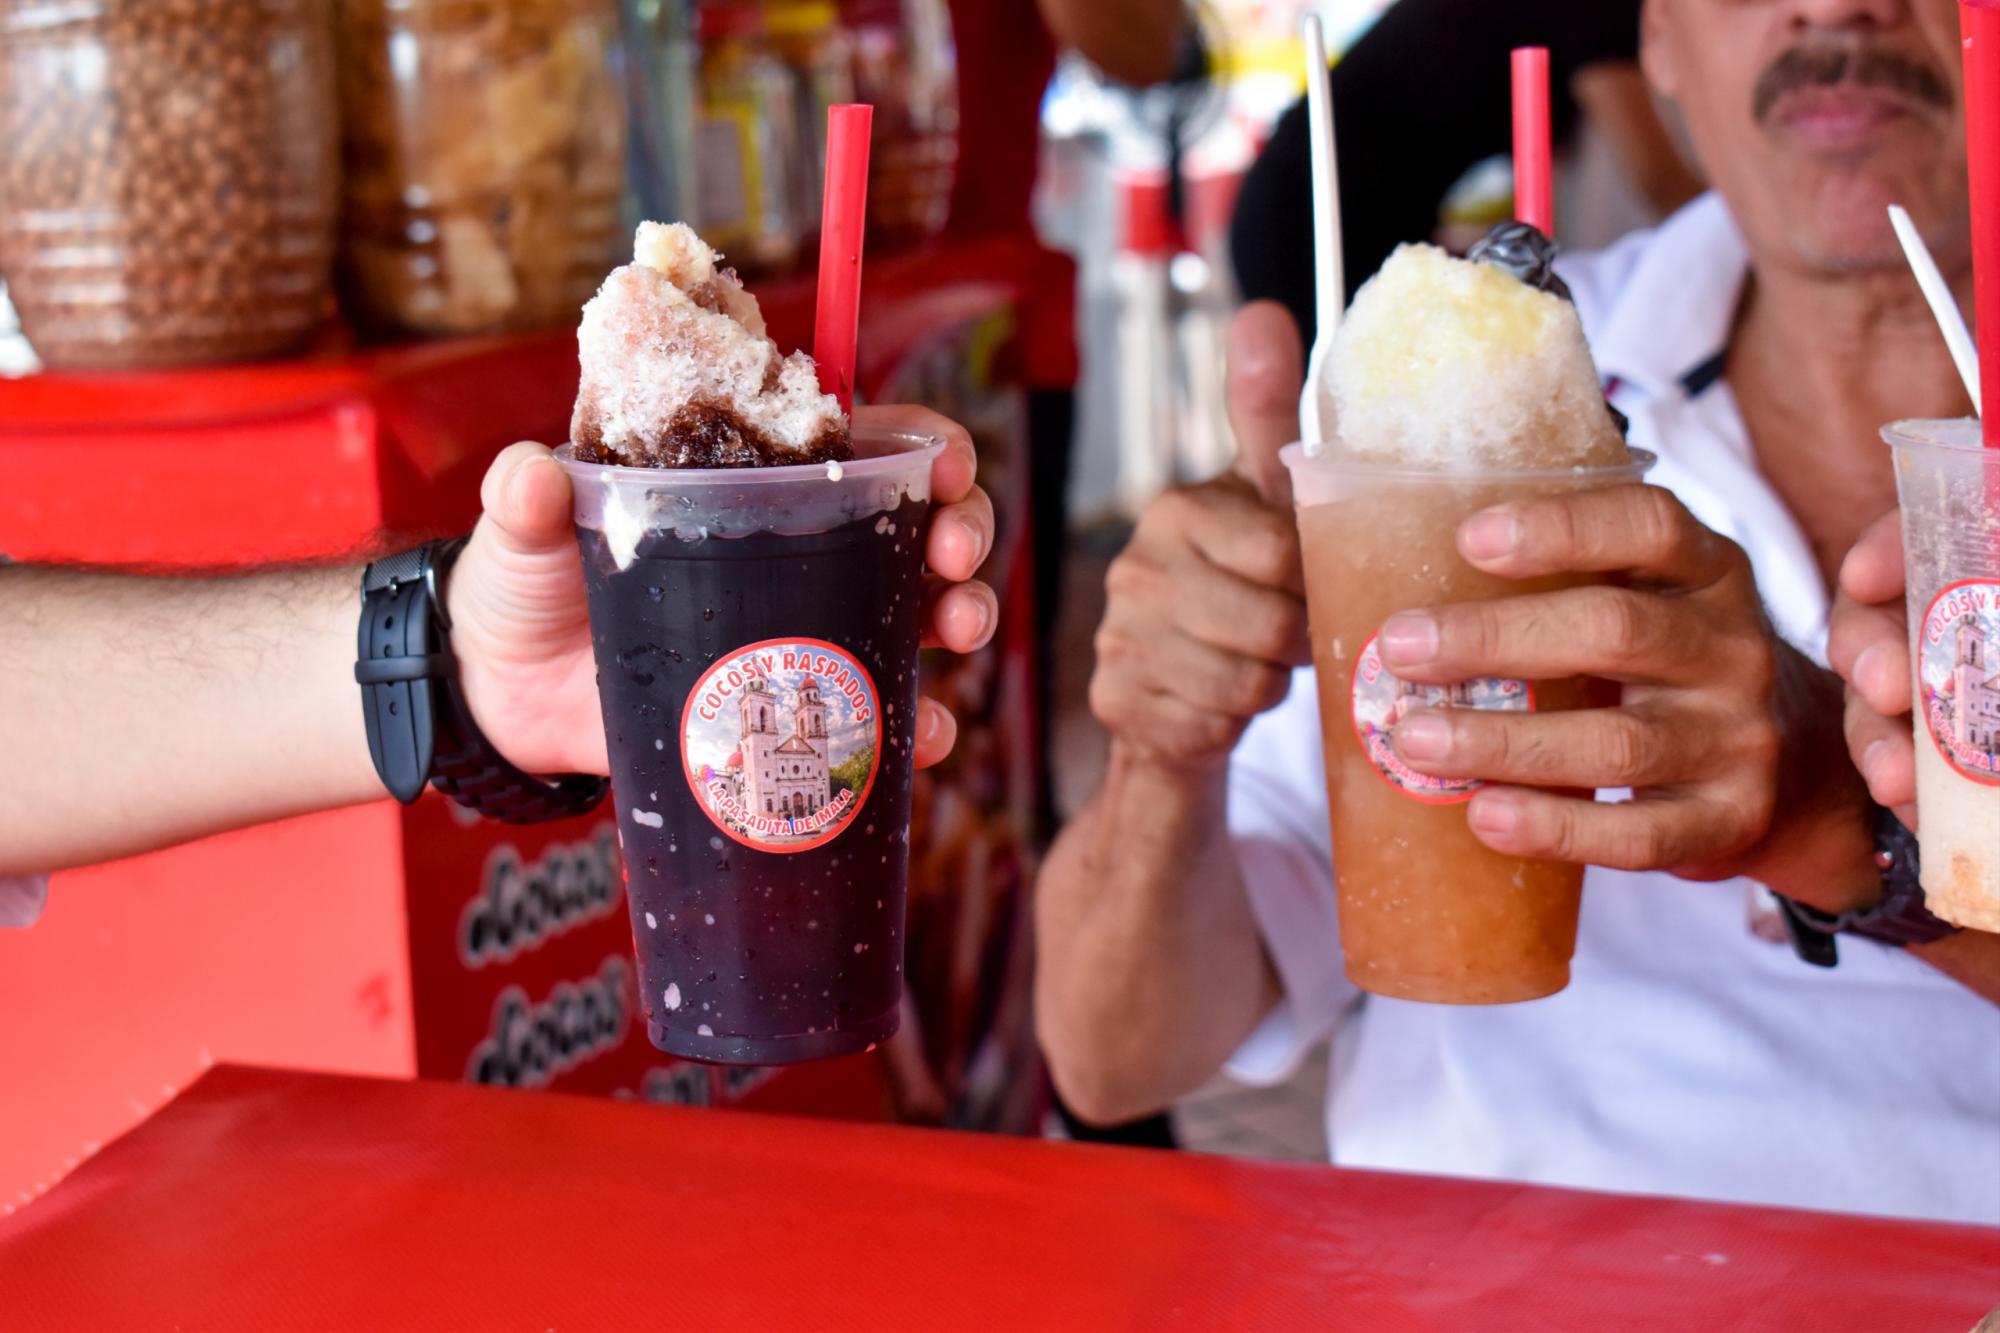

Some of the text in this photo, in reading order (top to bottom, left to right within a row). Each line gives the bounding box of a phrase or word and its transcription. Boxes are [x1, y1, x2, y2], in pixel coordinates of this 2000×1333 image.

[1928, 594, 1970, 643] COCOS
[1975, 592, 1987, 609] Y
[699, 652, 870, 721] COCOS Y RASPADOS
[709, 781, 854, 834] LA PASADITA DE IMALA
